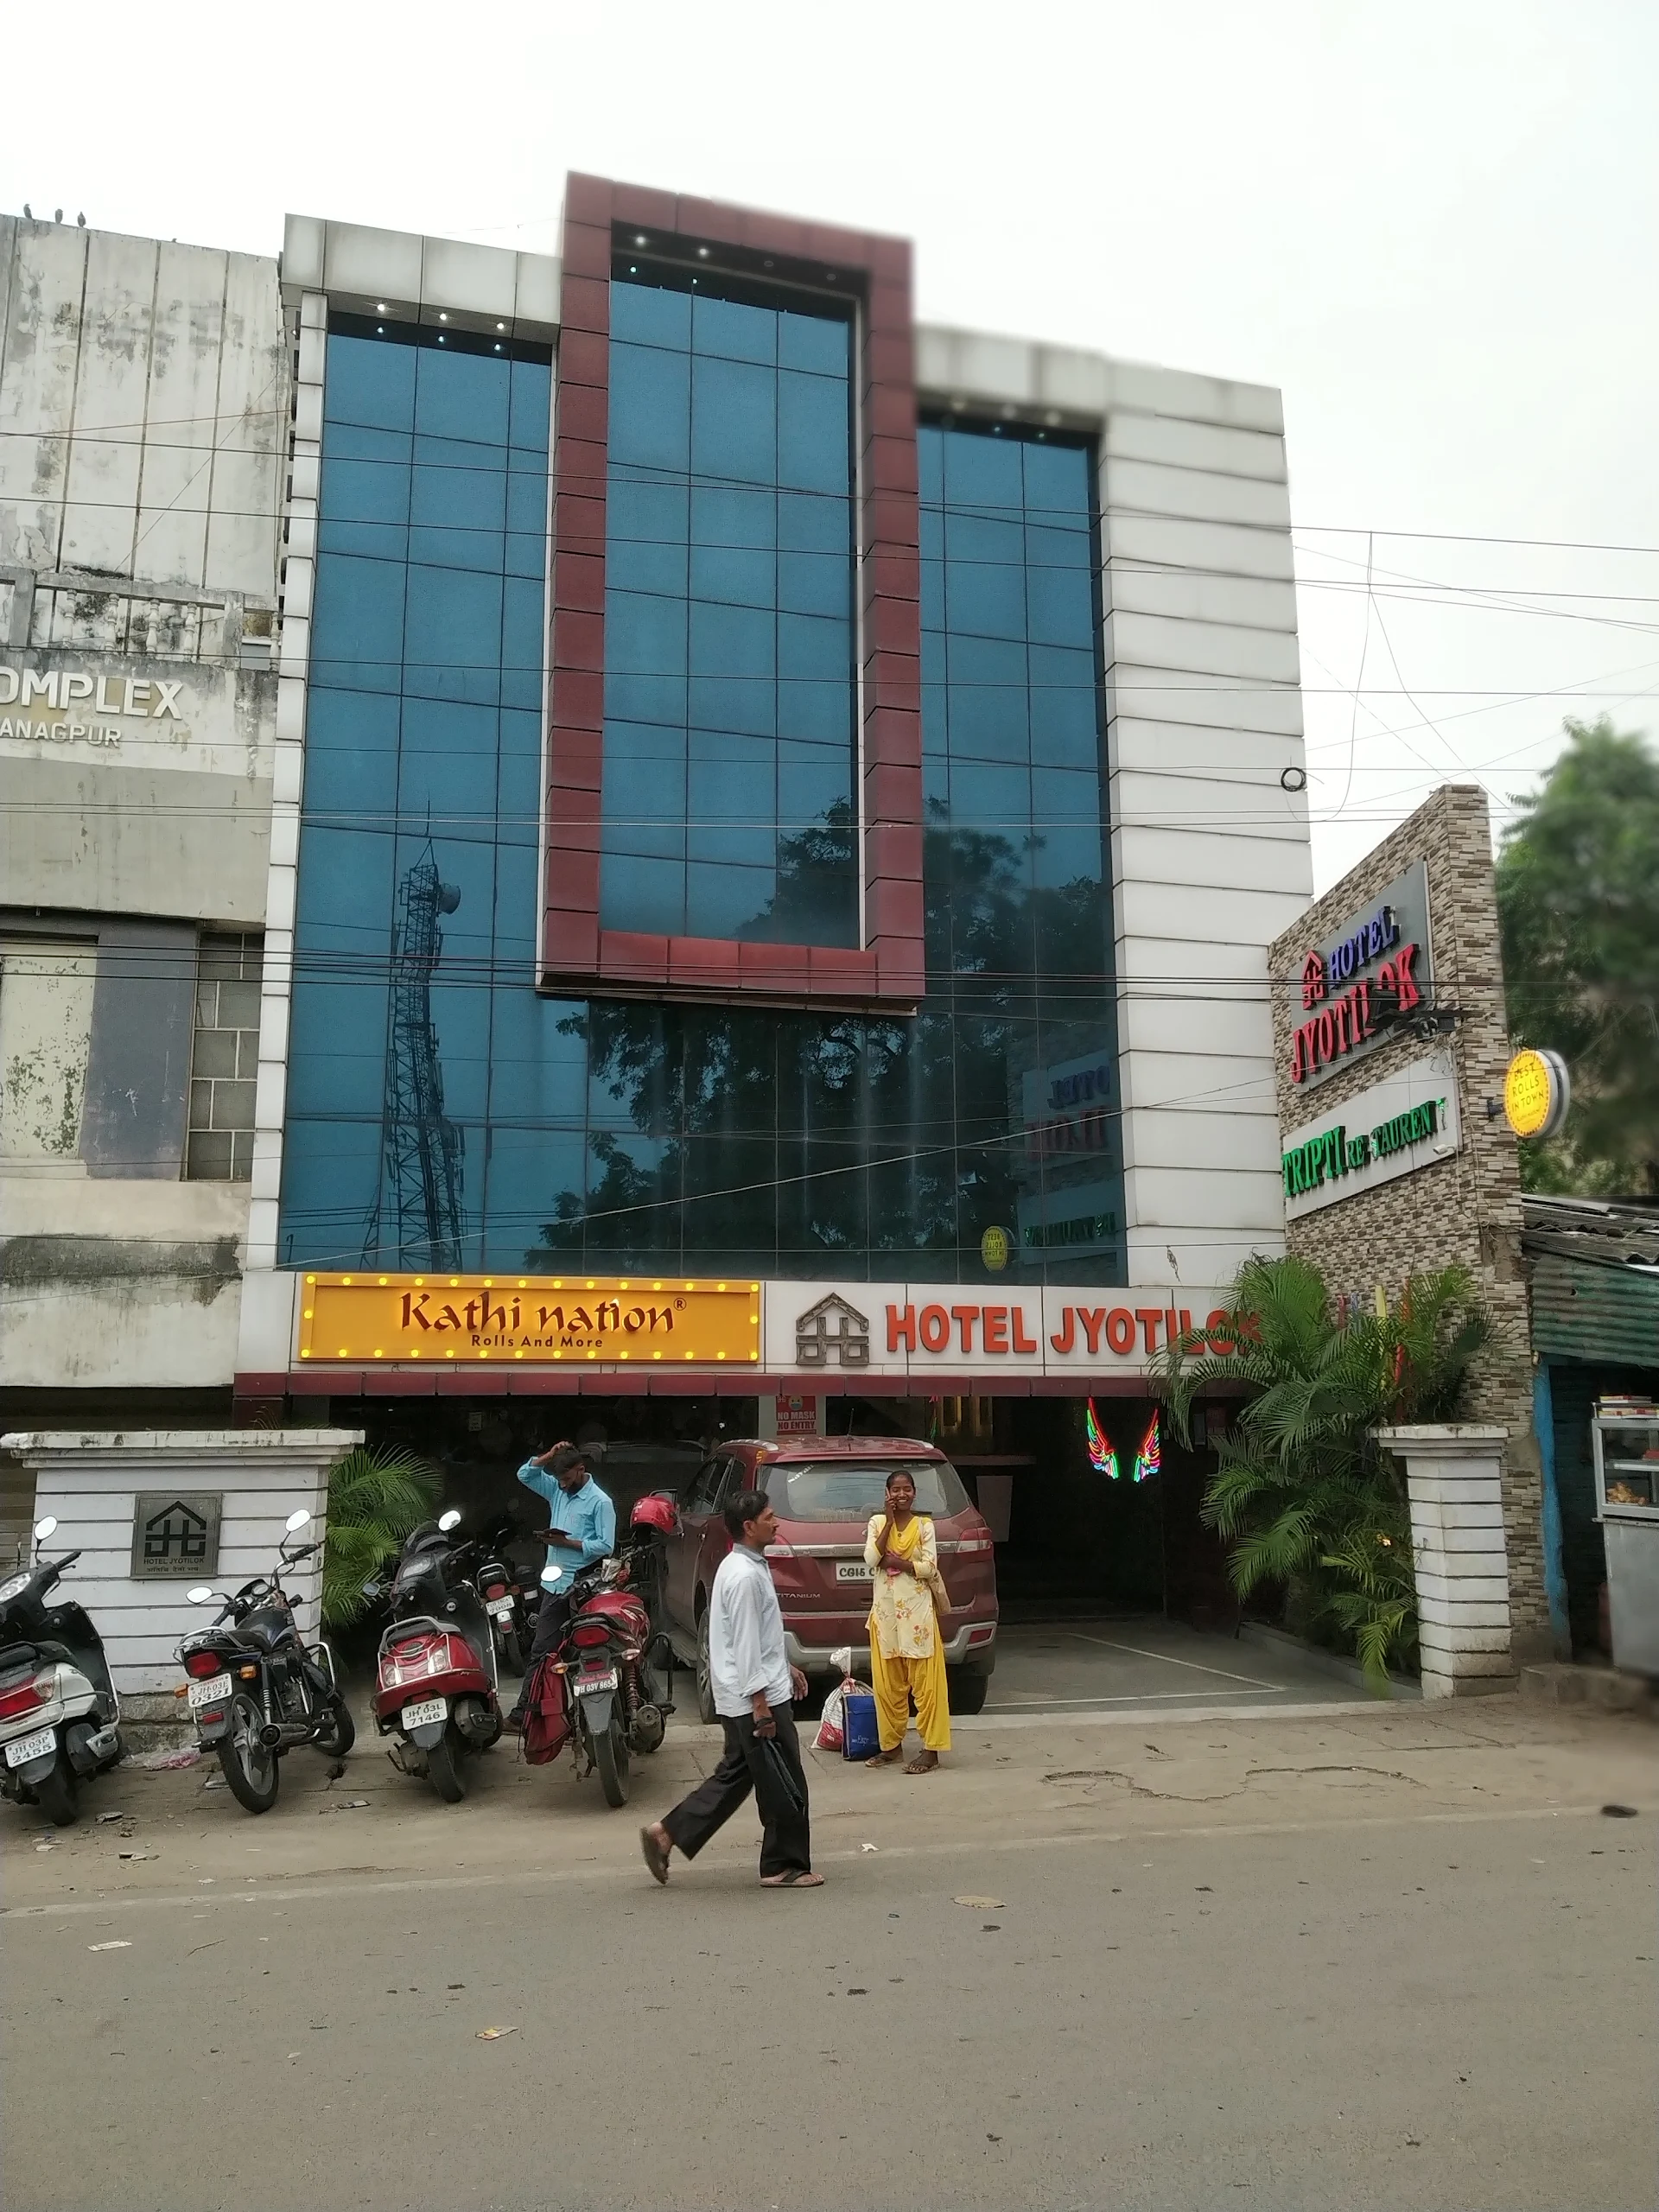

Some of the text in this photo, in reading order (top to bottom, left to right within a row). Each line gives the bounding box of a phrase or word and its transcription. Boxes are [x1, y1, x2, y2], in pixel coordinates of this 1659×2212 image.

[1328, 906, 1401, 991] HOTEL
[1514, 1062, 1535, 1083] BEST
[1512, 1074, 1540, 1098] ROLLS
[1511, 1090, 1545, 1113] IN TOWN
[1283, 1125, 1348, 1198] TRIPTI
[399, 1291, 521, 1332] Kathi
[886, 1304, 1037, 1353] HOTEL
[472, 1334, 603, 1348] Rolls And More
[778, 1411, 816, 1421] NO MASK
[778, 1421, 816, 1430] NO ENTRY
[191, 1687, 230, 1706] 0321
[405, 1710, 420, 1719] JH
[410, 1712, 441, 1726] 7146
